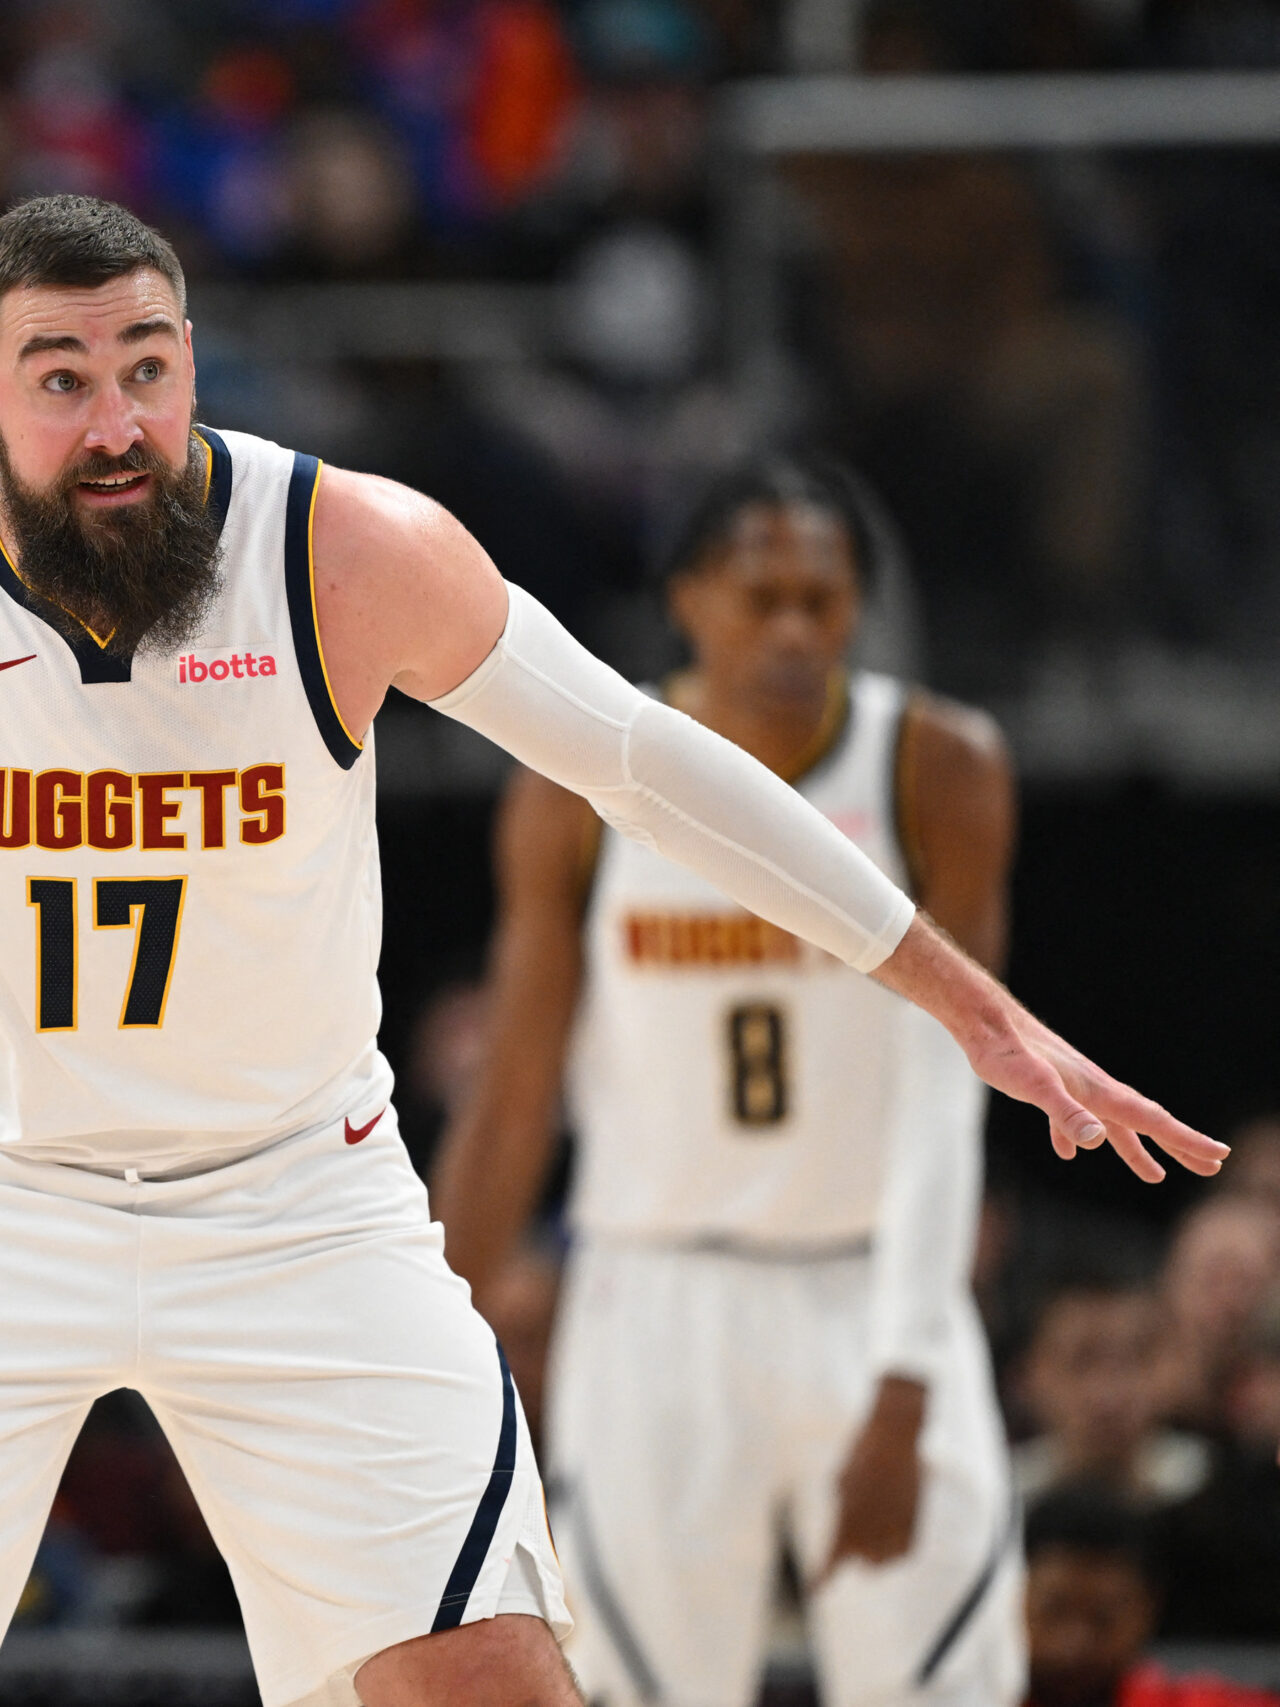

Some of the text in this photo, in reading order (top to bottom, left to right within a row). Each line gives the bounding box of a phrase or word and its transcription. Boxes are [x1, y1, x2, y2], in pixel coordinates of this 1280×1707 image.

[179, 652, 277, 683] ibotta
[26, 875, 188, 1033] 17
[726, 1003, 789, 1127] 8
